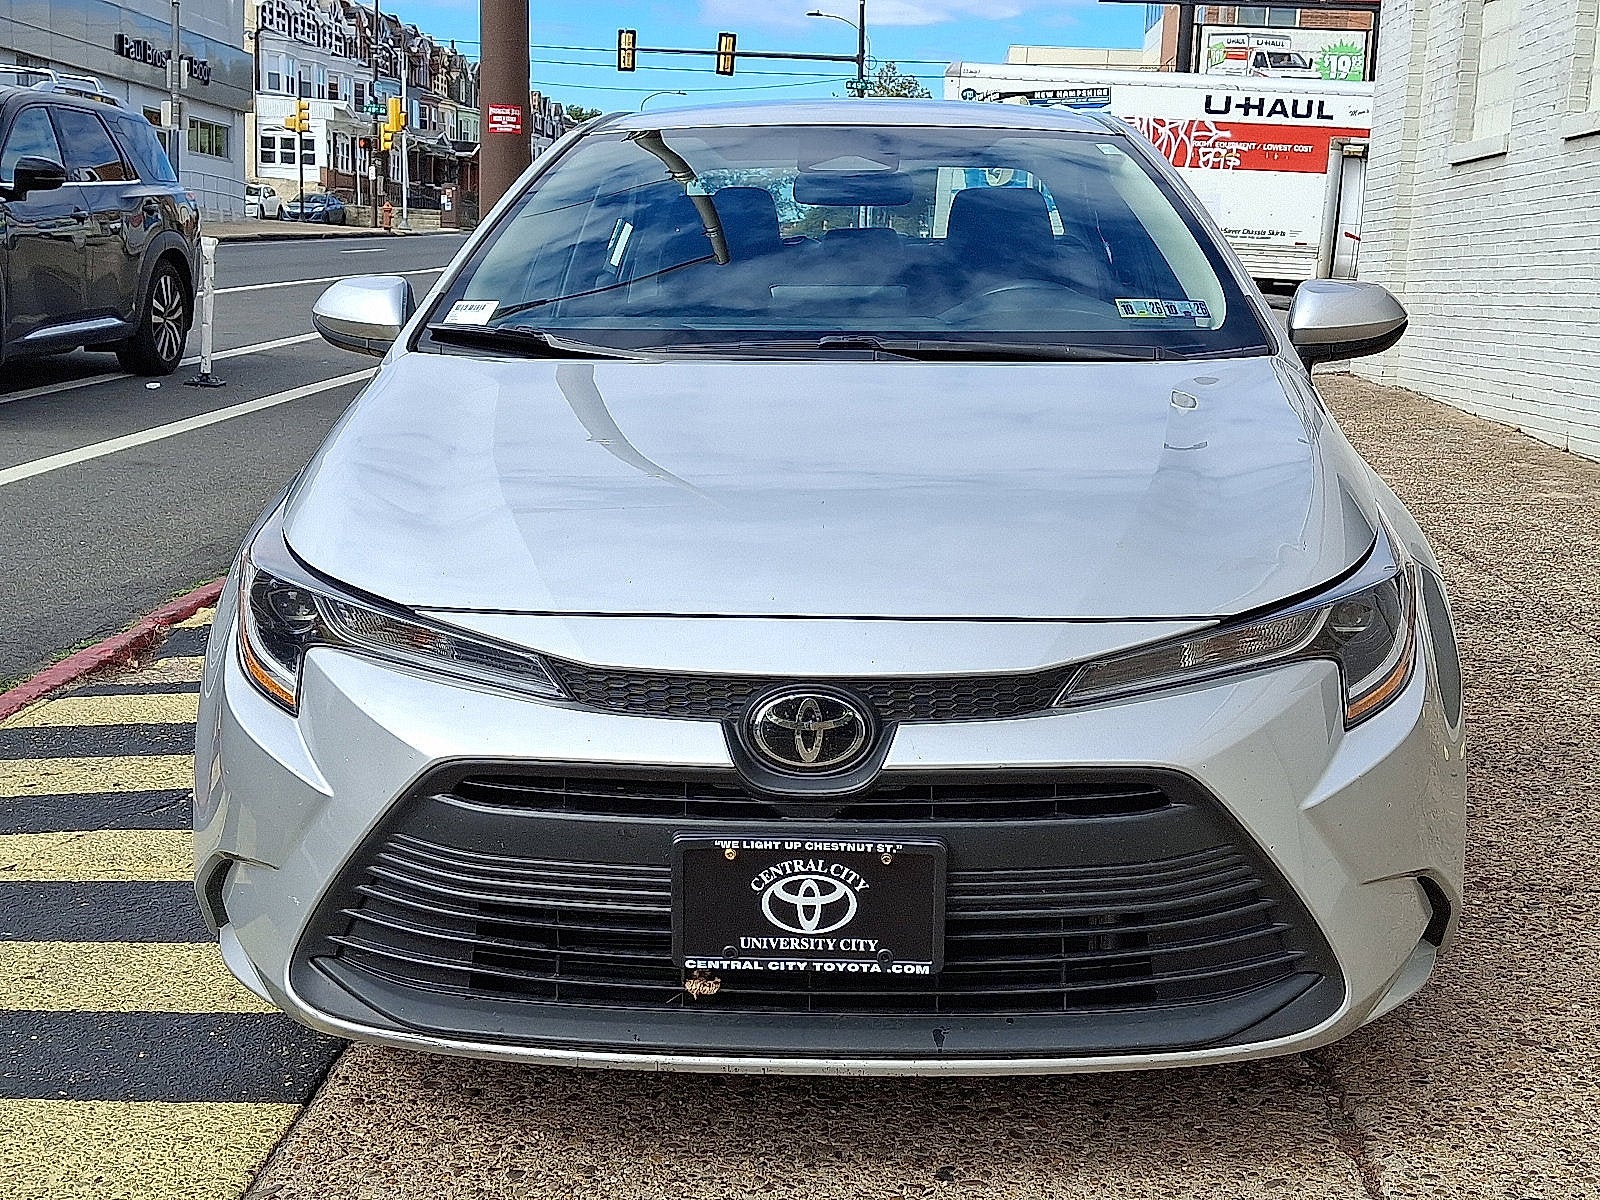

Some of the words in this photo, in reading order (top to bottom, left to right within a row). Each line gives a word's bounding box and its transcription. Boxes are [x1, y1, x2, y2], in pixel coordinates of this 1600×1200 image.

[123, 34, 144, 61] Paul
[1034, 90, 1053, 99] NEW
[1056, 88, 1109, 98] HAMPSHIRE
[1204, 94, 1334, 120] U-HAUL
[1214, 141, 1256, 151] EQUIPMENT
[1262, 143, 1293, 153] LOWEST
[1293, 145, 1314, 153] COST
[1242, 228, 1267, 236] Chassis
[1267, 229, 1286, 237] Skirts
[1149, 301, 1163, 314] 26
[1193, 302, 1209, 315] 26
[743, 840, 781, 850] LIGHT
[784, 841, 802, 850] UP
[805, 841, 873, 852] CHESTNUT
[751, 859, 828, 892] CENTRAL
[829, 863, 869, 892] CITY
[740, 937, 837, 950] UNIVERSITY
[839, 939, 878, 951] CITY
[684, 960, 763, 970] CENTRAL
[768, 960, 807, 971] CITY
[813, 962, 882, 973] TOYOTA
[886, 964, 930, 975] .COM
